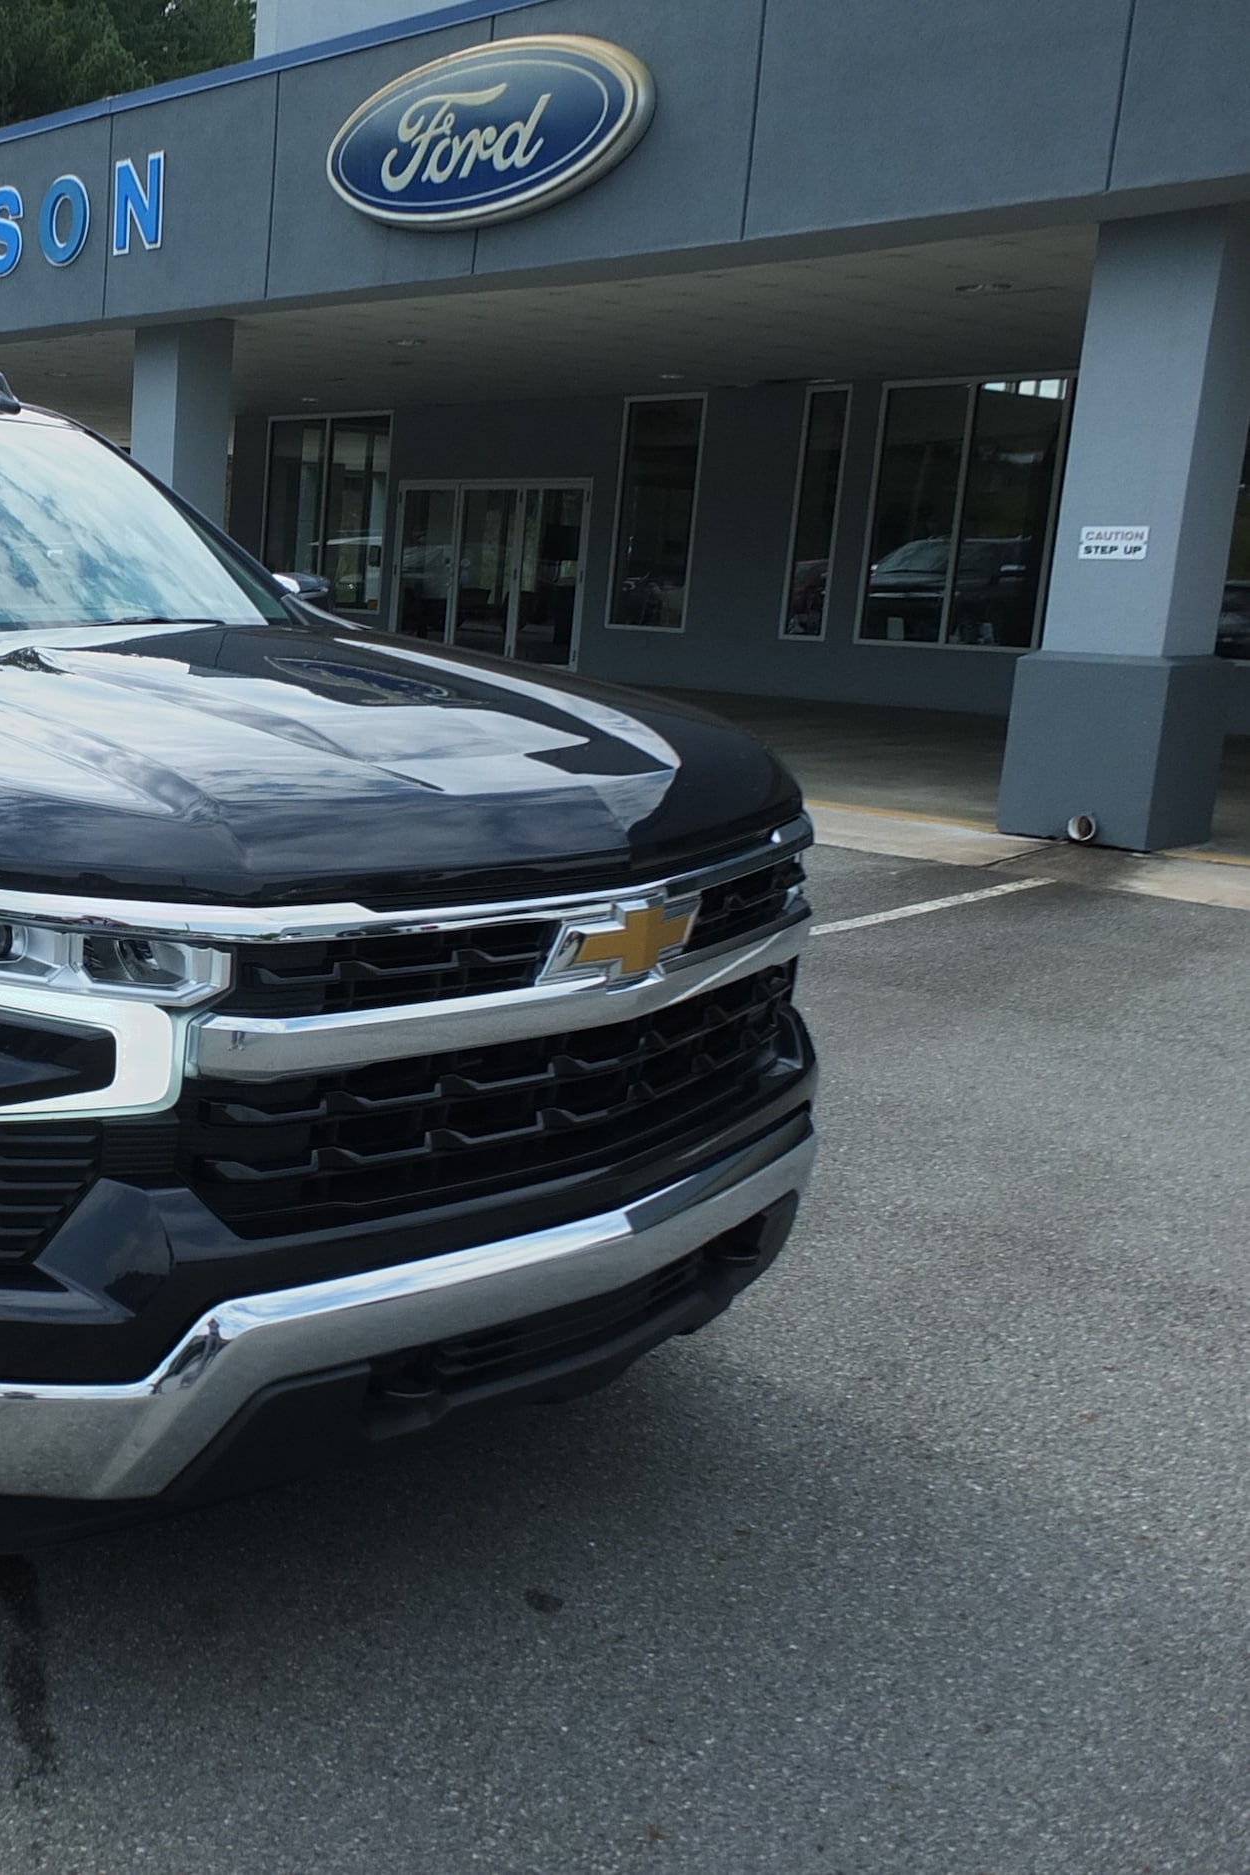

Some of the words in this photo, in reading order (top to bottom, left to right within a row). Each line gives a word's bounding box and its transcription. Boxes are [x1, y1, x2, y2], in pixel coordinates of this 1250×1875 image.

[381, 82, 551, 192] Ford
[1085, 530, 1145, 541] CAUTION
[1084, 545, 1119, 555] STEP
[1123, 545, 1142, 555] UP
